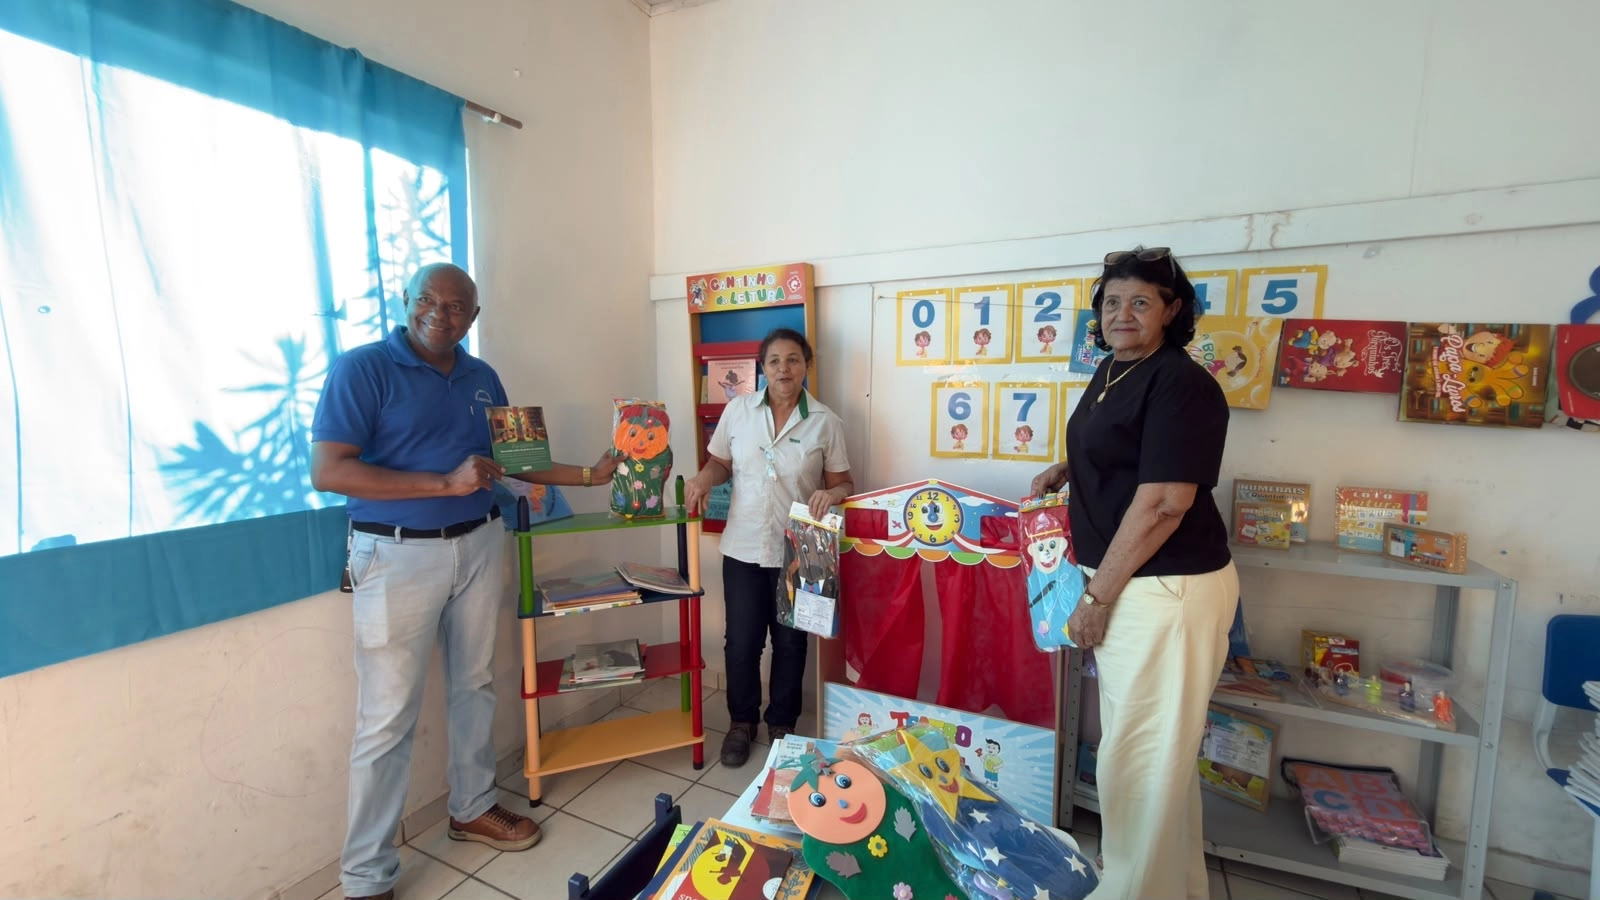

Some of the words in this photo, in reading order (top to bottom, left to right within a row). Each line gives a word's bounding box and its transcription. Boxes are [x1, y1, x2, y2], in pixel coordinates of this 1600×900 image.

[709, 272, 776, 291] CANTINHO
[730, 286, 785, 305] LEITURA
[1033, 292, 1062, 322] 2
[1261, 279, 1298, 315] 5
[912, 299, 935, 329] 0
[974, 296, 990, 325] 1
[1366, 330, 1390, 374] Porquinhos
[948, 392, 971, 420] 6
[1013, 392, 1037, 422] 7
[927, 491, 939, 500] 12
[907, 512, 913, 520] 9
[954, 514, 960, 523] 3
[929, 534, 936, 543] 6
[1313, 789, 1350, 811] C
